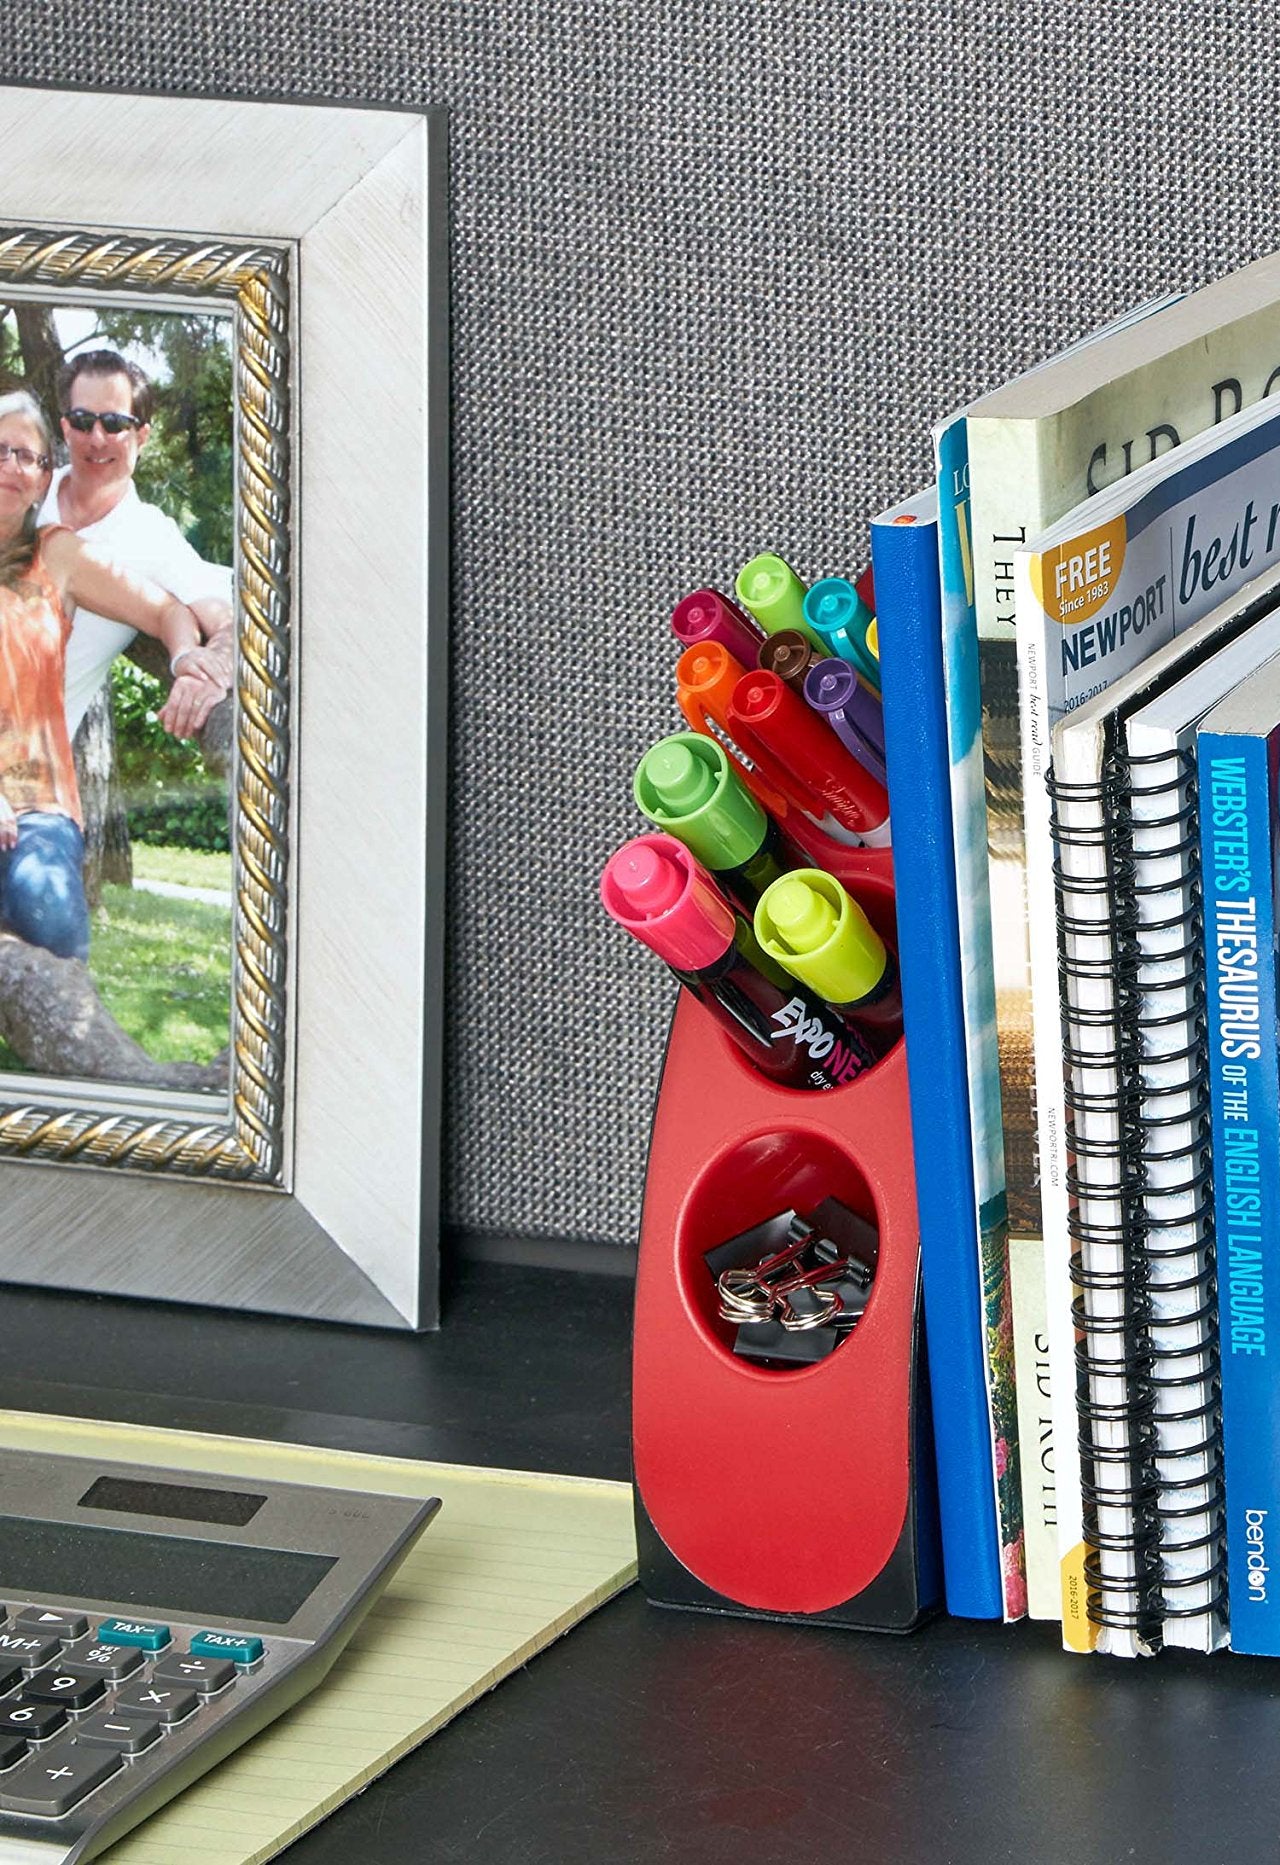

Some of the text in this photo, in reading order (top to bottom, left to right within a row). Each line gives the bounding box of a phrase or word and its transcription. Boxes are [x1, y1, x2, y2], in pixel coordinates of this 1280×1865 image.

[1054, 540, 1112, 600] FREE
[1179, 500, 1258, 605] best
[1059, 581, 1109, 617] Since 1983
[1061, 573, 1167, 678] NEWPORT
[1027, 643, 1038, 690] NEWPORT
[1031, 747, 1042, 777] GUIDE
[770, 996, 834, 1058] EXPO
[810, 1070, 828, 1086] dry
[822, 1039, 870, 1085] NE
[1210, 756, 1266, 1357] WEBSTER'S THESAURUS OF THE ENGLISH LANGUAGE
[1245, 1509, 1270, 1602] bendon
[1068, 1575, 1080, 1620] 2016-2017
[50, 1677, 77, 1691] 9
[9, 1707, 36, 1721] 6
